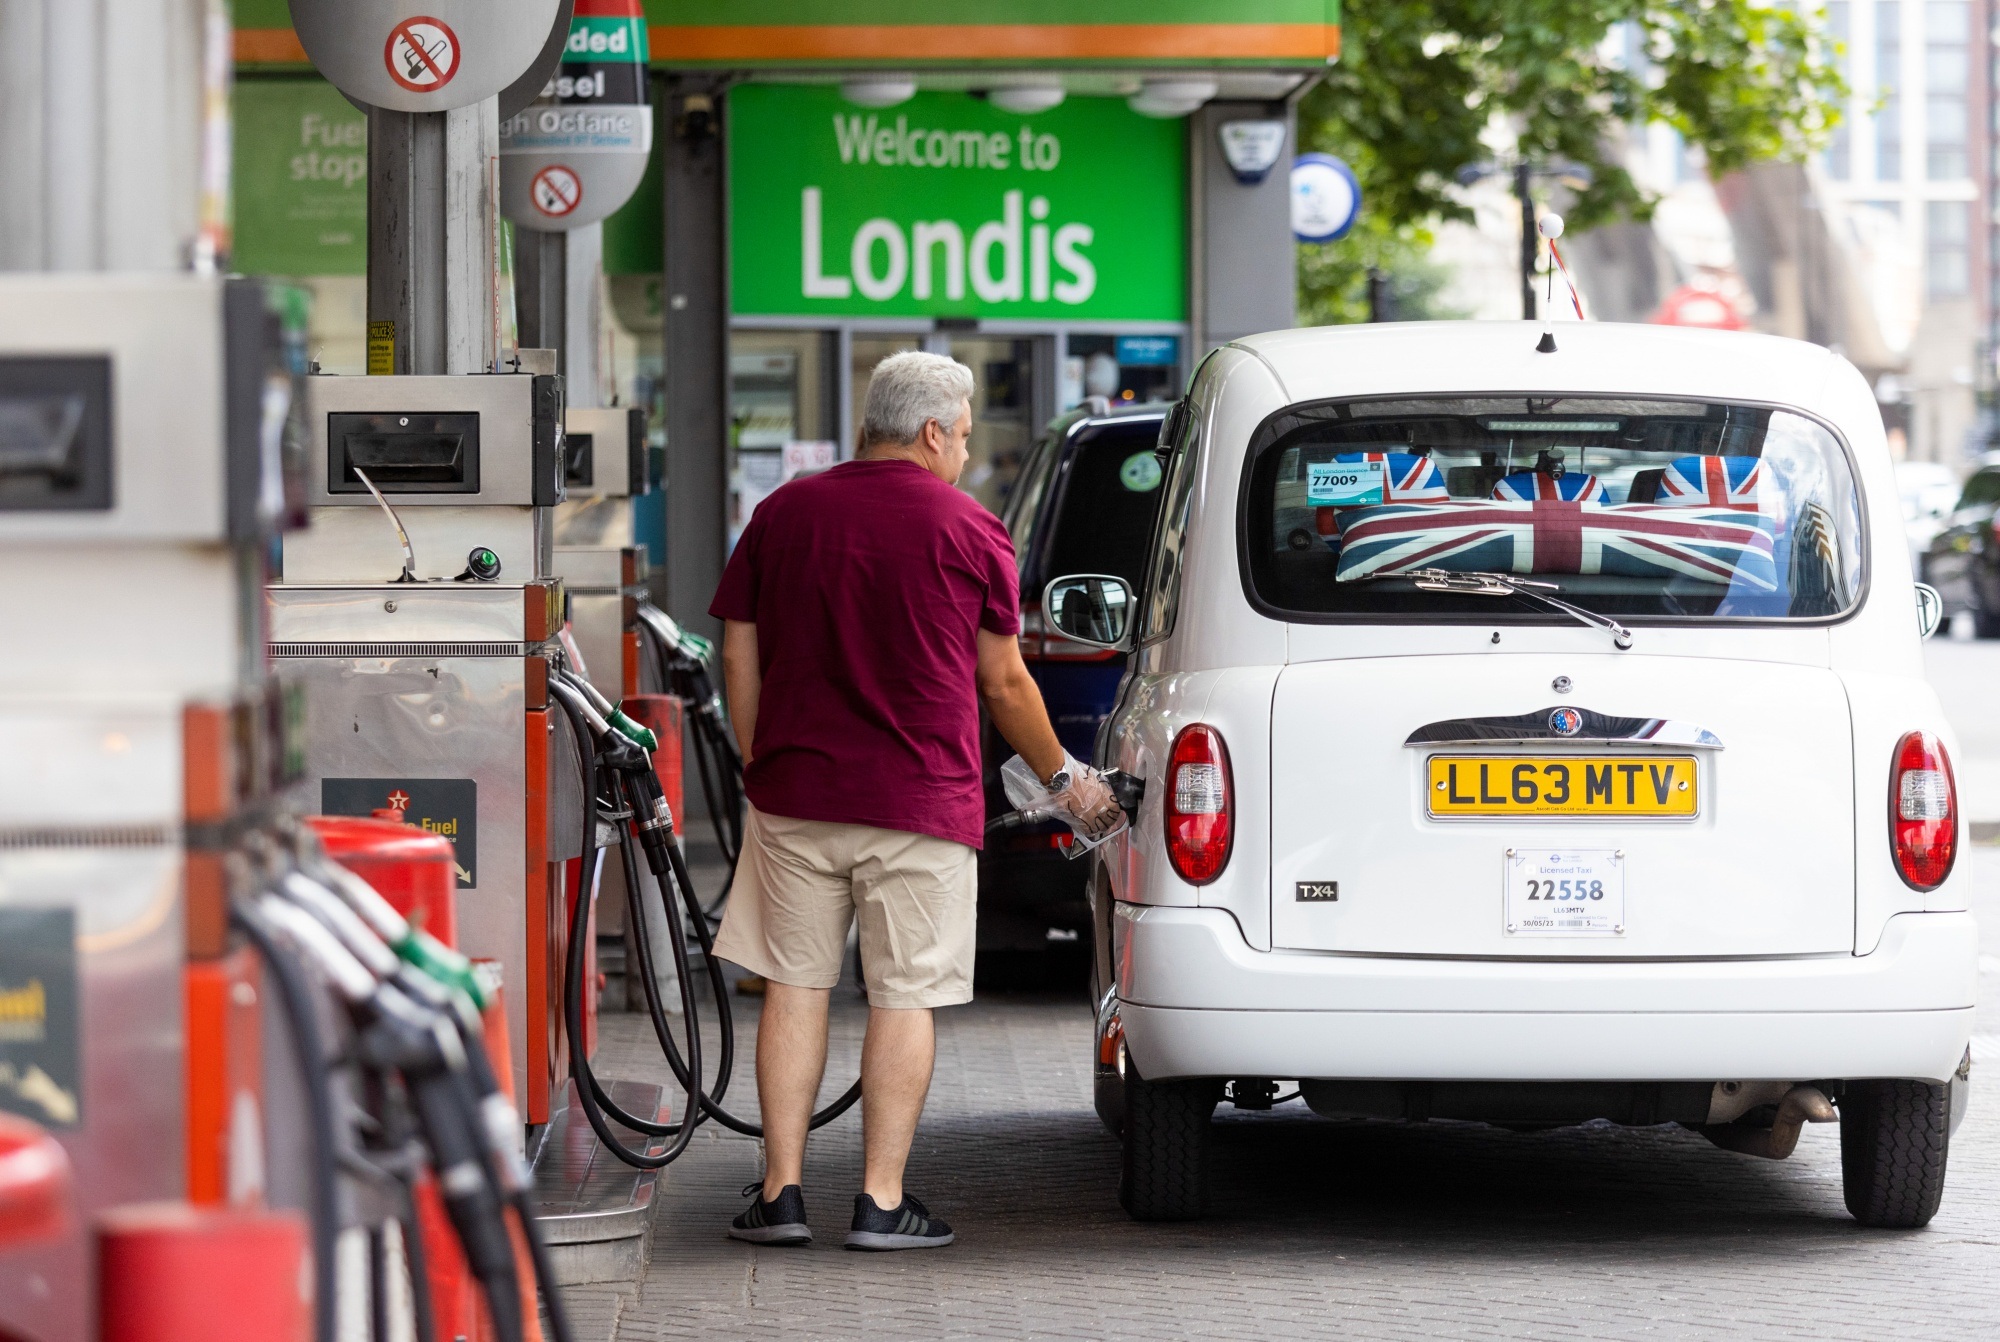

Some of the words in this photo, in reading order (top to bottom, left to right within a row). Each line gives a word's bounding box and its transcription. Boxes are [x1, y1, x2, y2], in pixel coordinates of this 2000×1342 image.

[564, 26, 628, 53] ded
[538, 110, 632, 134] Octane
[833, 114, 1012, 170] Welcome
[1019, 126, 1060, 171] to
[289, 152, 367, 188] stop
[801, 186, 1098, 305] Londis
[1313, 475, 1358, 486] 77009
[1448, 763, 1570, 805] LL63
[1586, 764, 1675, 805] MTV
[422, 817, 457, 835] Fuel
[1298, 885, 1335, 898] TX4
[1527, 880, 1604, 901] 22558
[1523, 919, 1554, 927] 30/05/23
